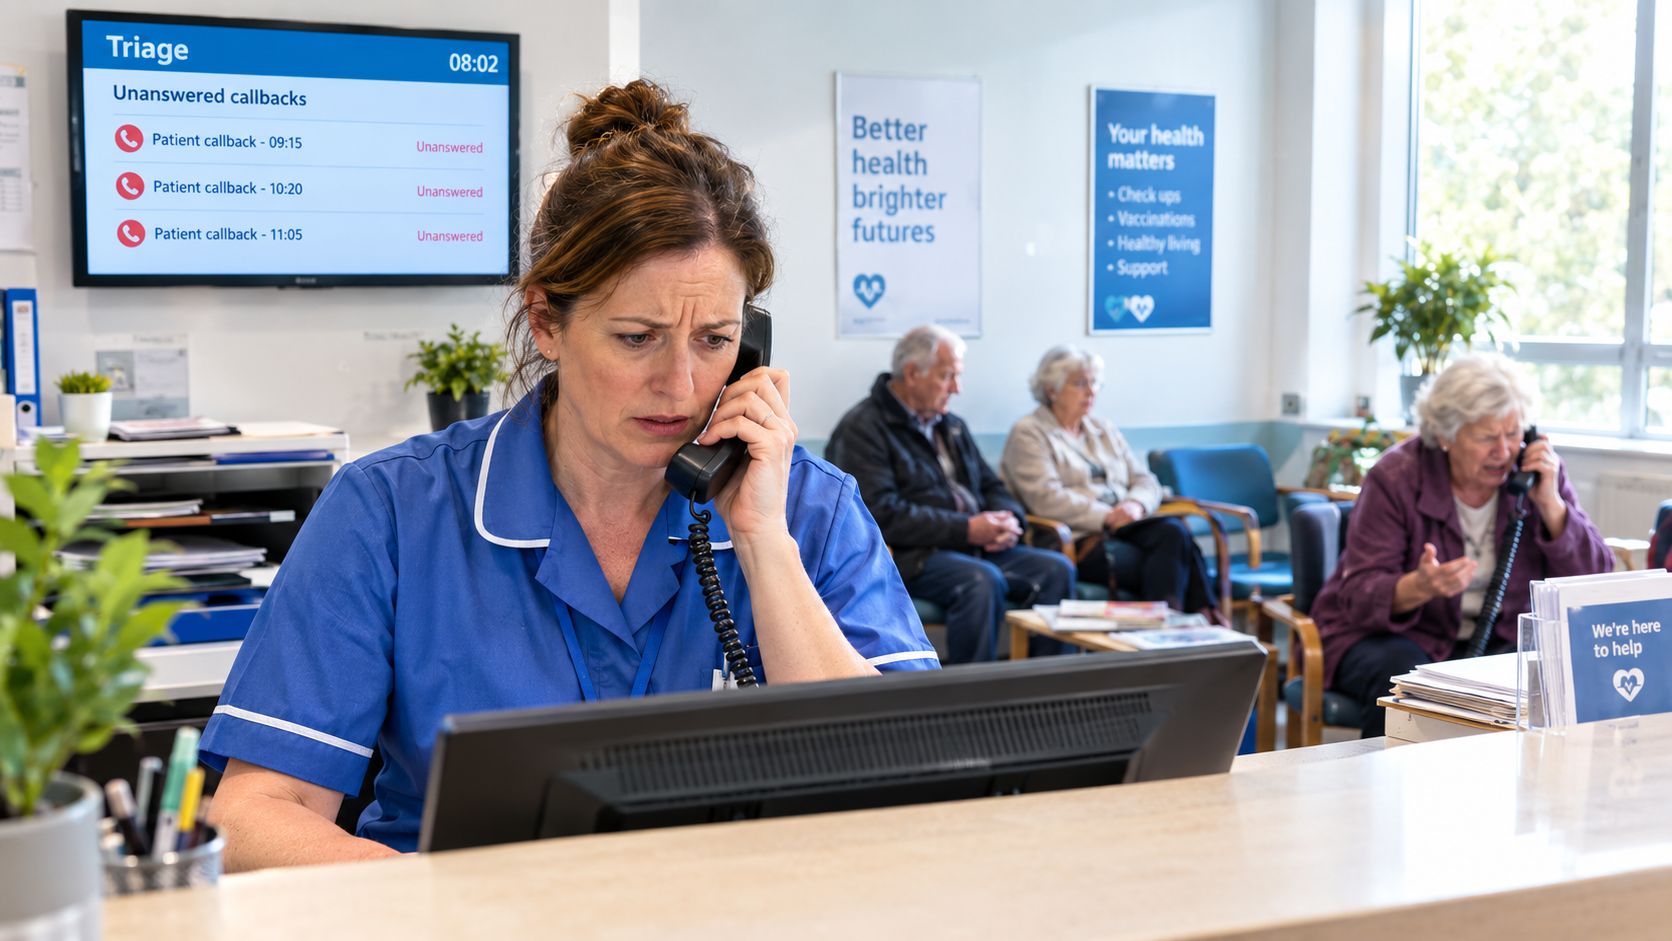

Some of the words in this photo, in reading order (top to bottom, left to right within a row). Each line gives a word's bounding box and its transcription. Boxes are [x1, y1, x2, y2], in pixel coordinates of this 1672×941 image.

[106, 34, 189, 66] Triage
[449, 53, 499, 74] 08:02
[113, 84, 225, 104] Unanswered
[230, 89, 307, 107] callbacks
[852, 115, 928, 142] Better
[1108, 123, 1148, 144] Your
[1151, 124, 1204, 147] health
[152, 132, 200, 148] Patient
[204, 134, 257, 149] callback
[268, 135, 303, 150] 09:15
[416, 141, 484, 154] Unanswered
[852, 149, 928, 176] health
[1108, 151, 1175, 171] matters
[153, 180, 201, 194] Patient
[205, 181, 257, 195] callback
[269, 182, 303, 196] 10:20
[417, 185, 484, 199] Unanswered
[1118, 186, 1156, 203] Check
[1158, 190, 1181, 206] ups
[852, 184, 947, 216] brighter
[1117, 210, 1195, 227] Vaccinations
[154, 227, 202, 241] Patient
[206, 227, 257, 241] callback
[270, 228, 303, 242] 11:05
[417, 230, 484, 243] Unanswered
[851, 217, 936, 244] futures
[1117, 235, 1165, 255] Healthy
[1167, 236, 1200, 255] living
[1117, 260, 1168, 278] Support
[1592, 622, 1630, 639] We're
[1632, 619, 1661, 635] here
[1593, 643, 1609, 658] to
[1612, 639, 1643, 658] help
